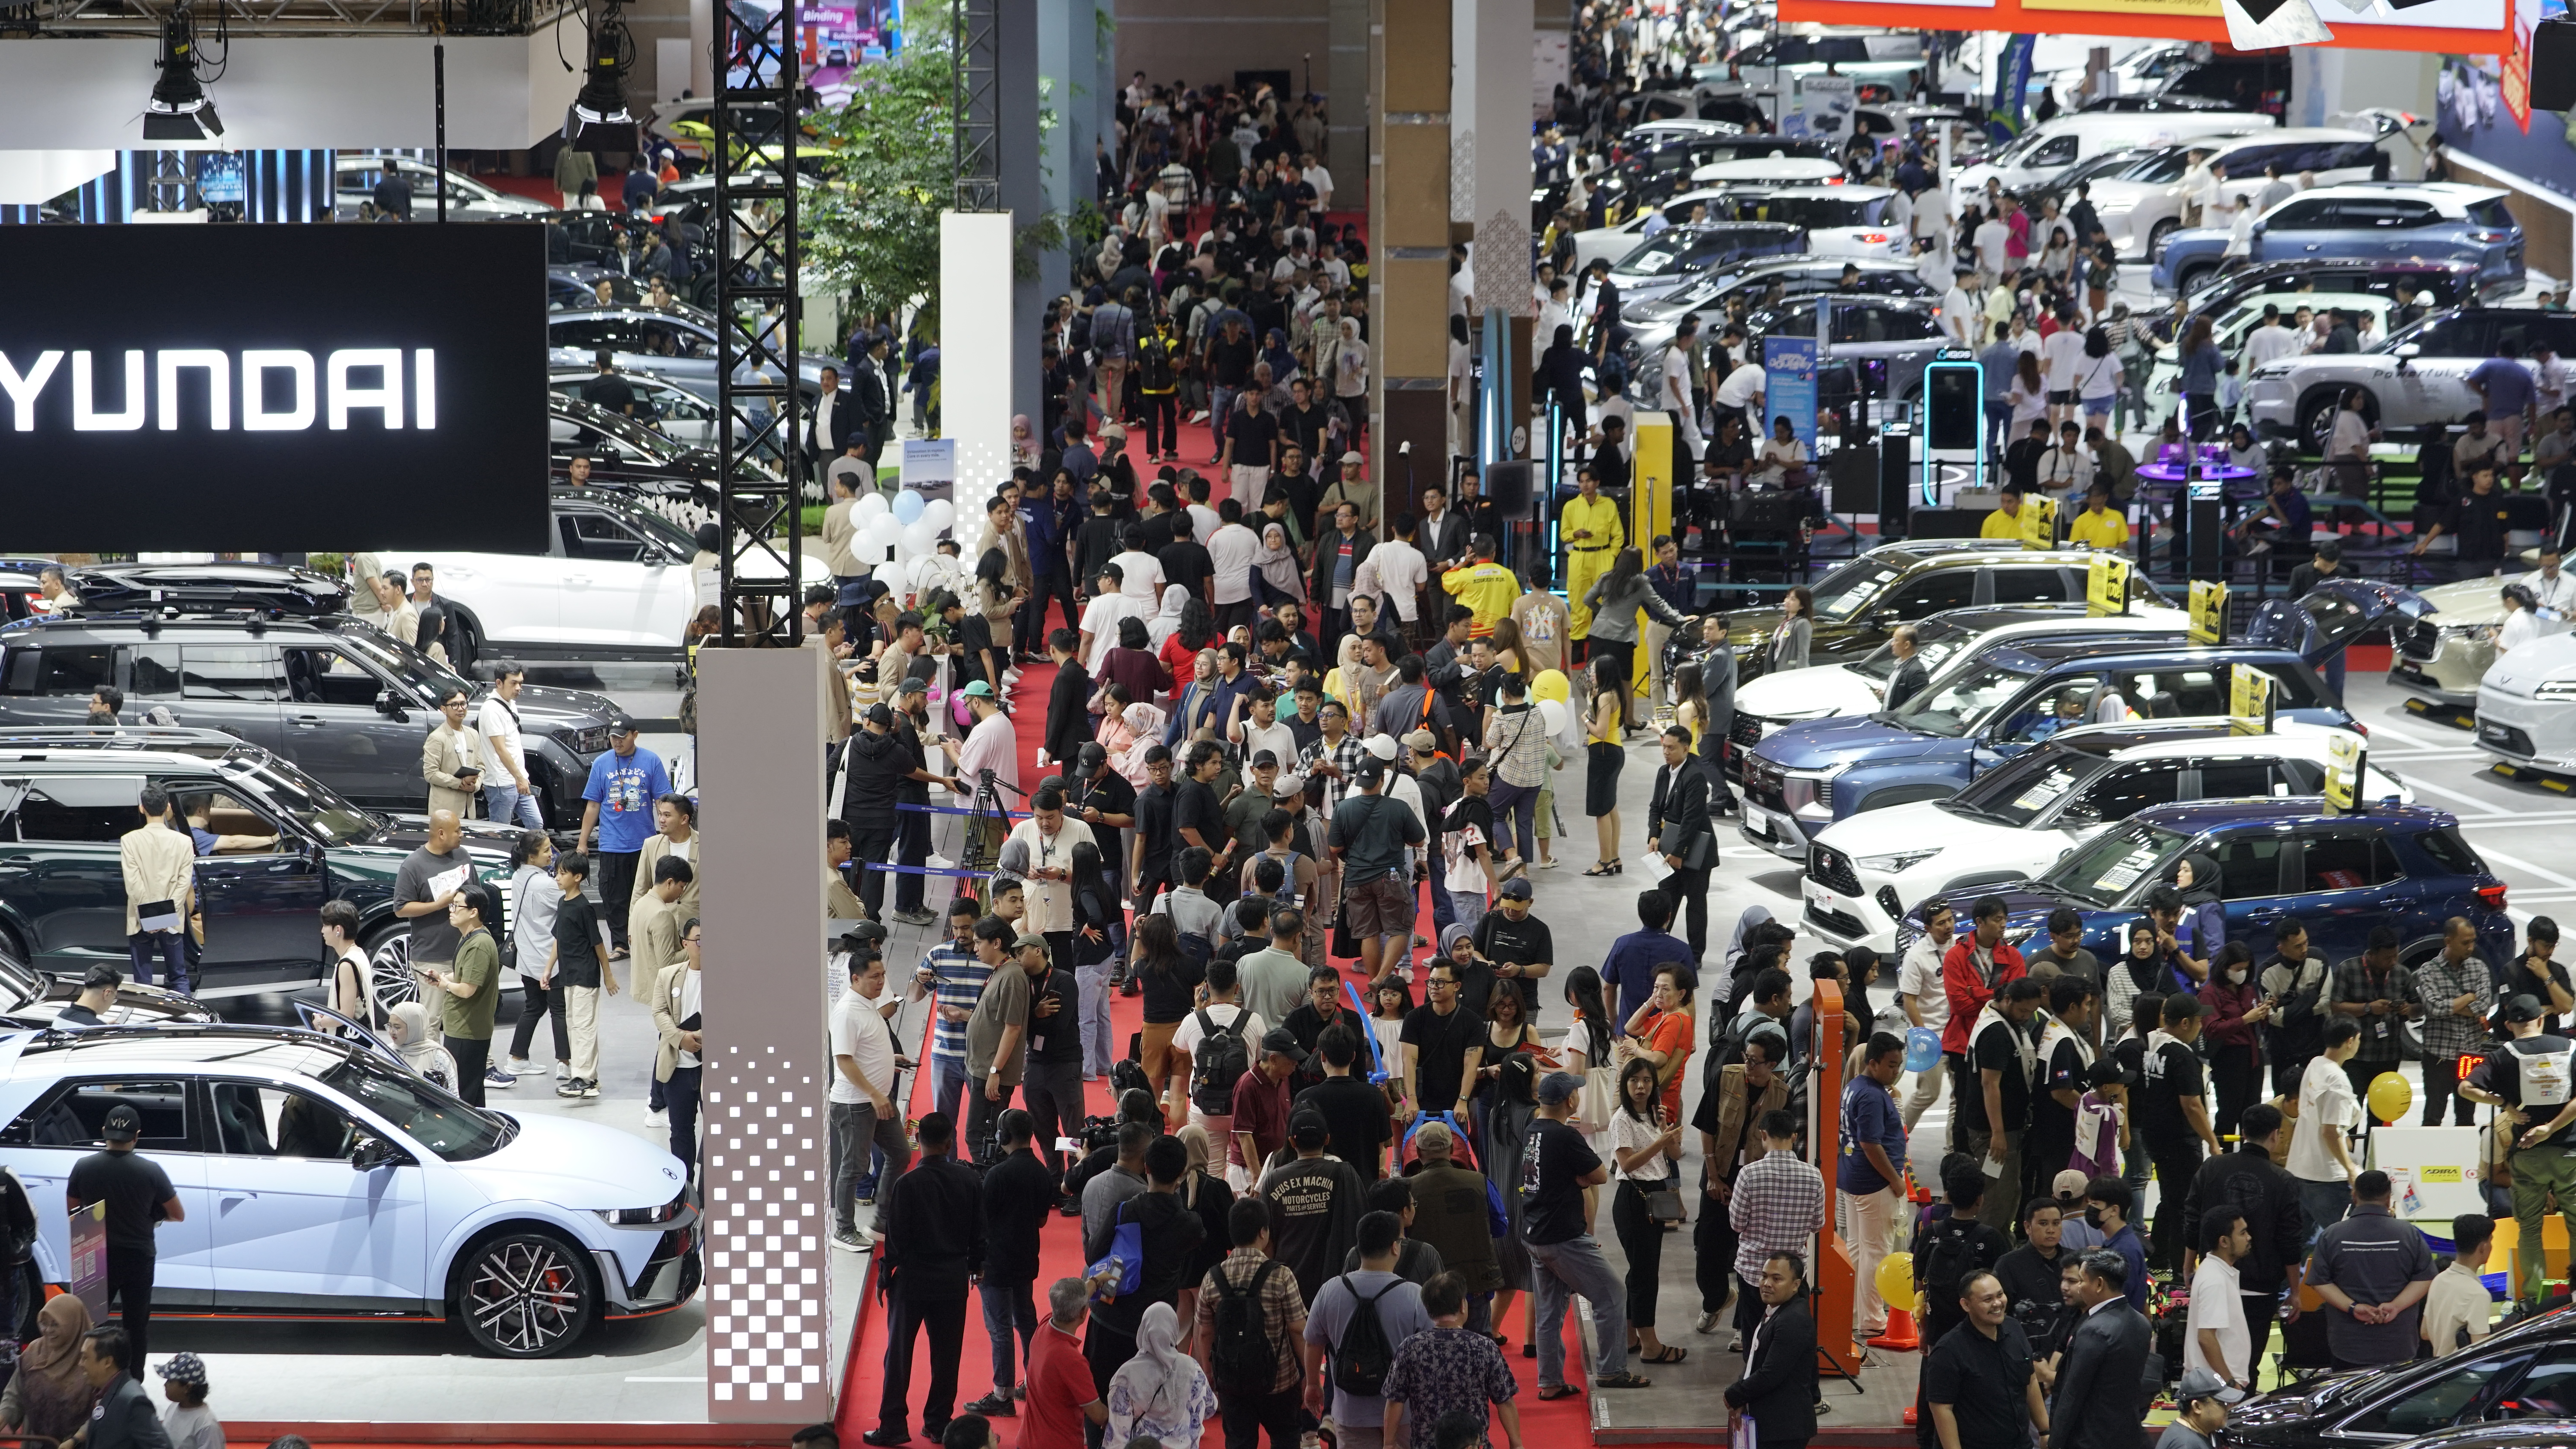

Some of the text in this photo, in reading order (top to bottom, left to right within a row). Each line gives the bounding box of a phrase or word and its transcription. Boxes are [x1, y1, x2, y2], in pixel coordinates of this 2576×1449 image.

[804, 9, 844, 24] Binding
[1947, 351, 1971, 359] IQOS
[2373, 368, 2455, 379] Powerful,
[0, 349, 436, 431] YUNDAI
[607, 768, 646, 779] はんぎょどん
[1270, 1176, 1333, 1201] DEUS EX MACHIN
[1282, 1191, 1330, 1205] MOTORCYCLES
[1307, 1202, 1326, 1210] SERVICE
